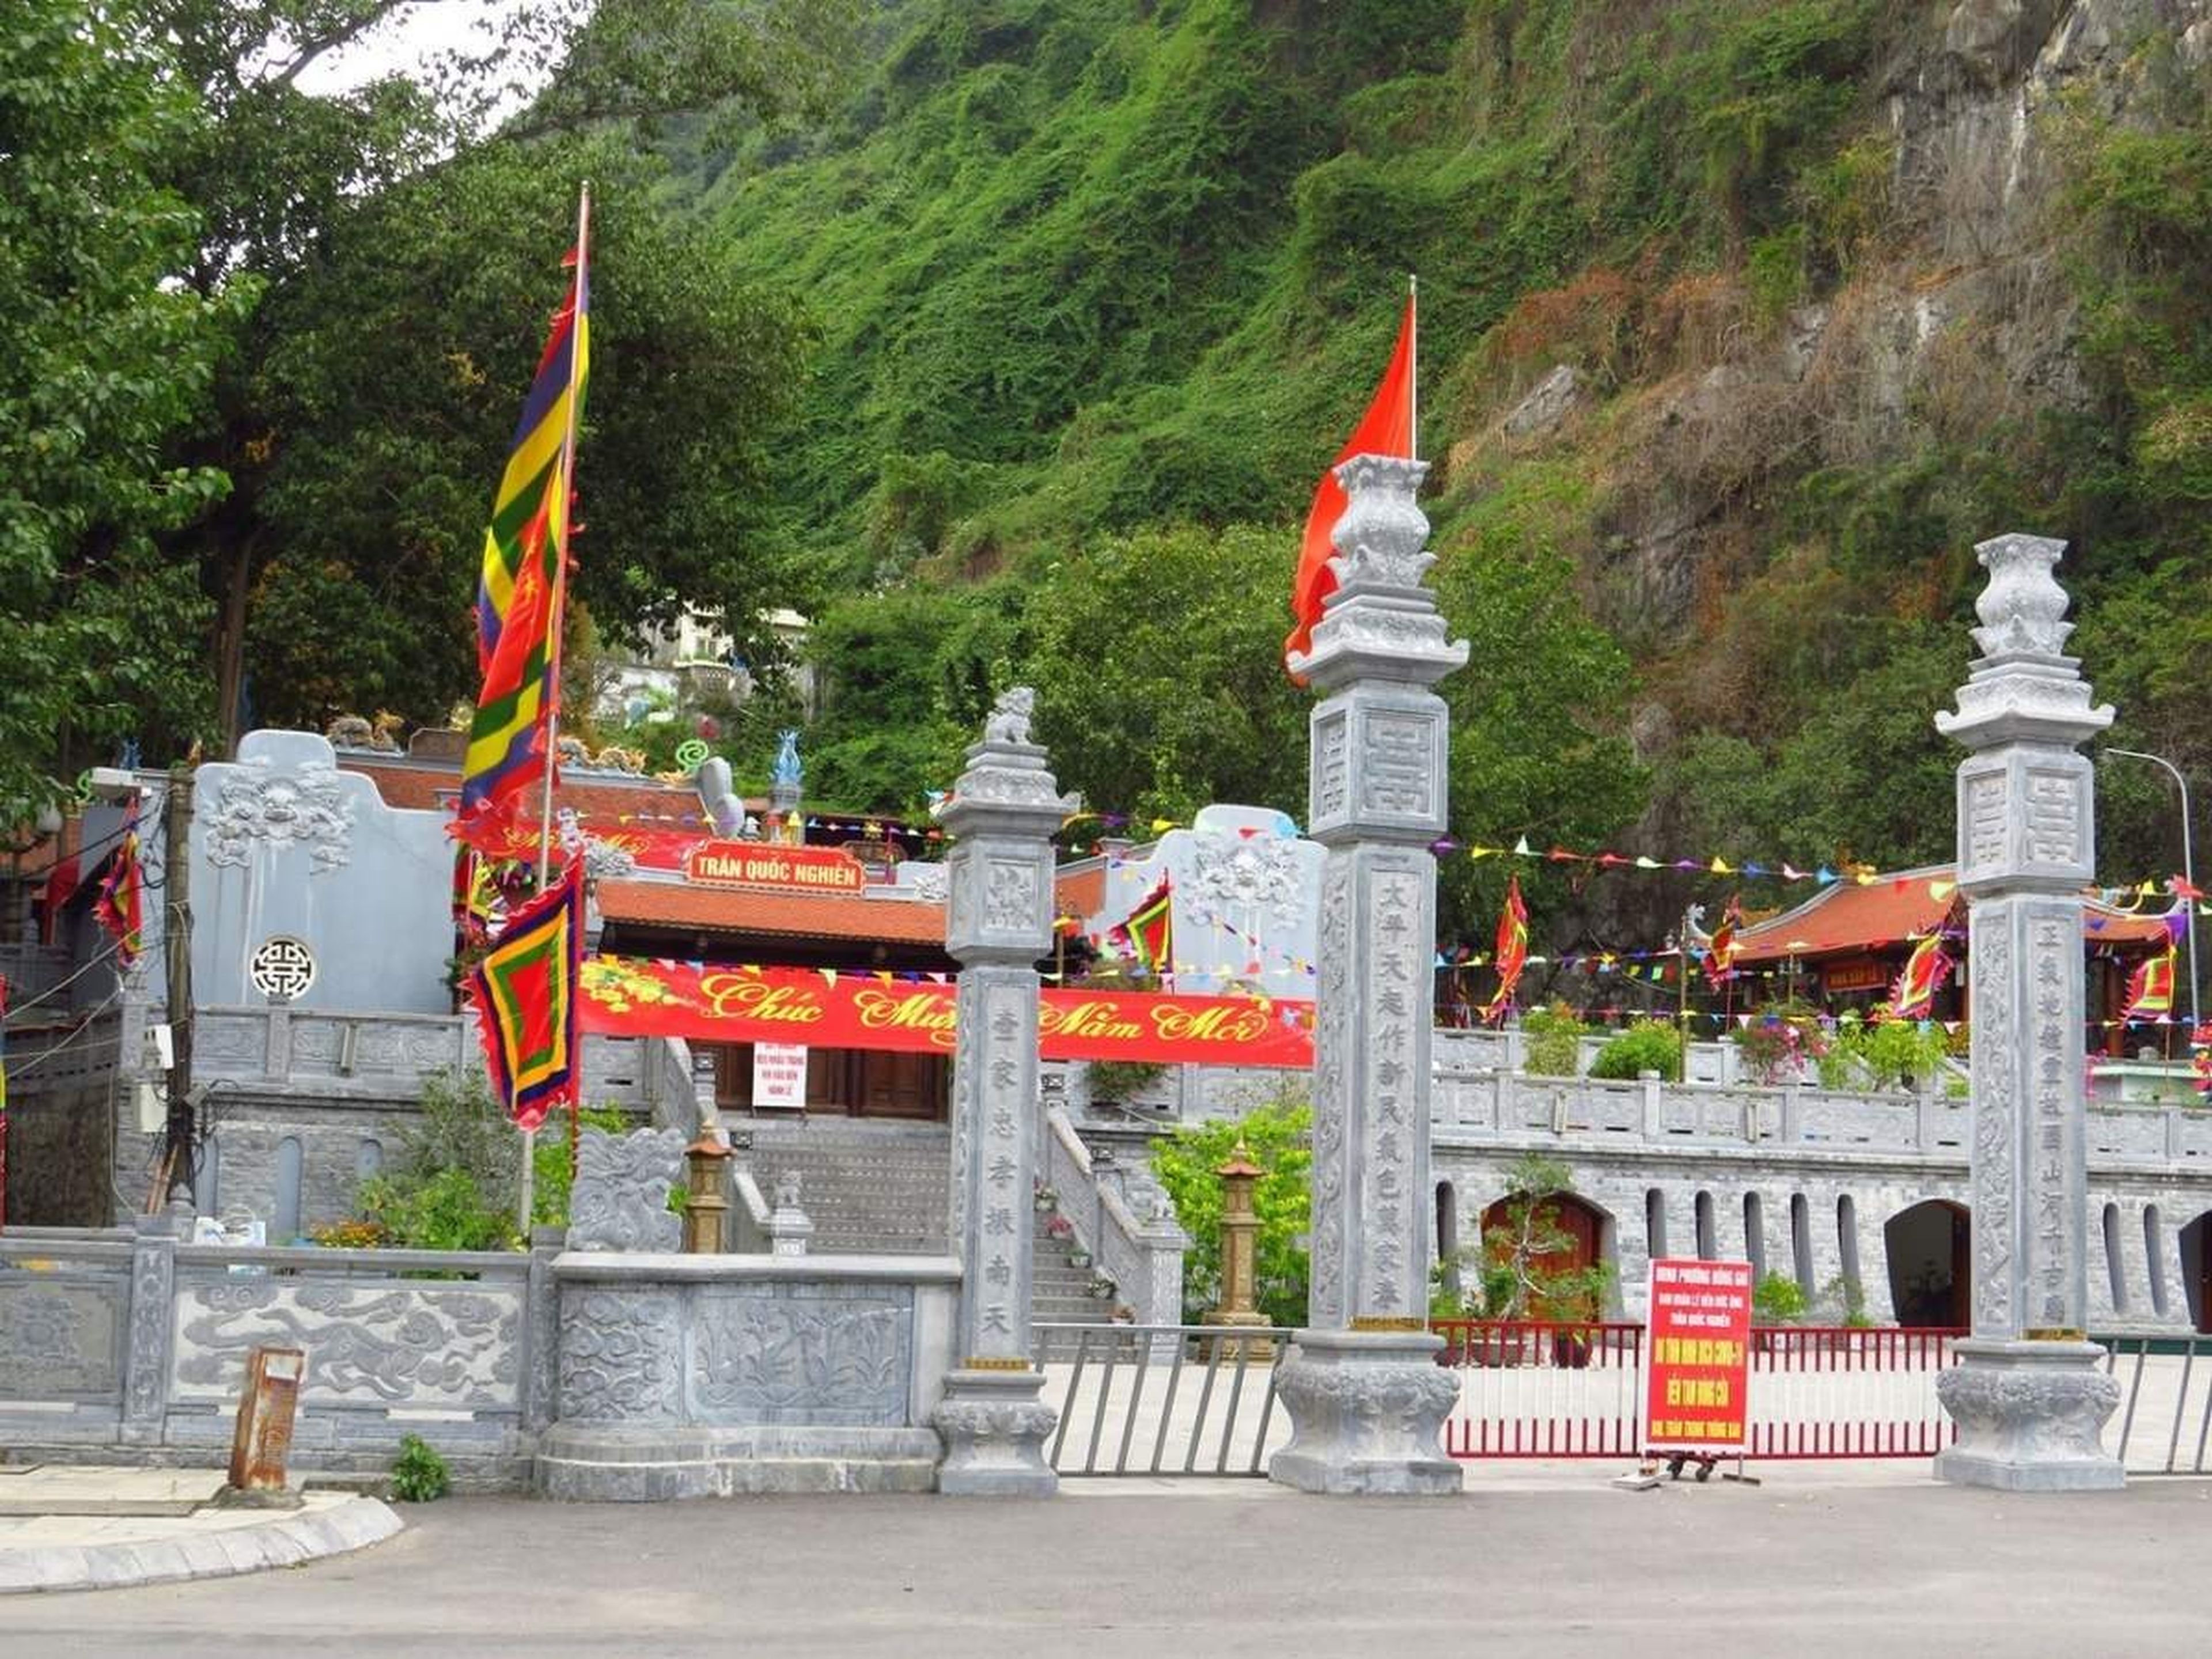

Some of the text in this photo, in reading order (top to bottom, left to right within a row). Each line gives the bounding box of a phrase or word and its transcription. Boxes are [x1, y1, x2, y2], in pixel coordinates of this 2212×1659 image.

[747, 855, 790, 881] QUỐC
[699, 974, 825, 1024] Chúc
[1039, 1001, 1143, 1039] Năm
[1150, 1003, 1269, 1042] Mới
